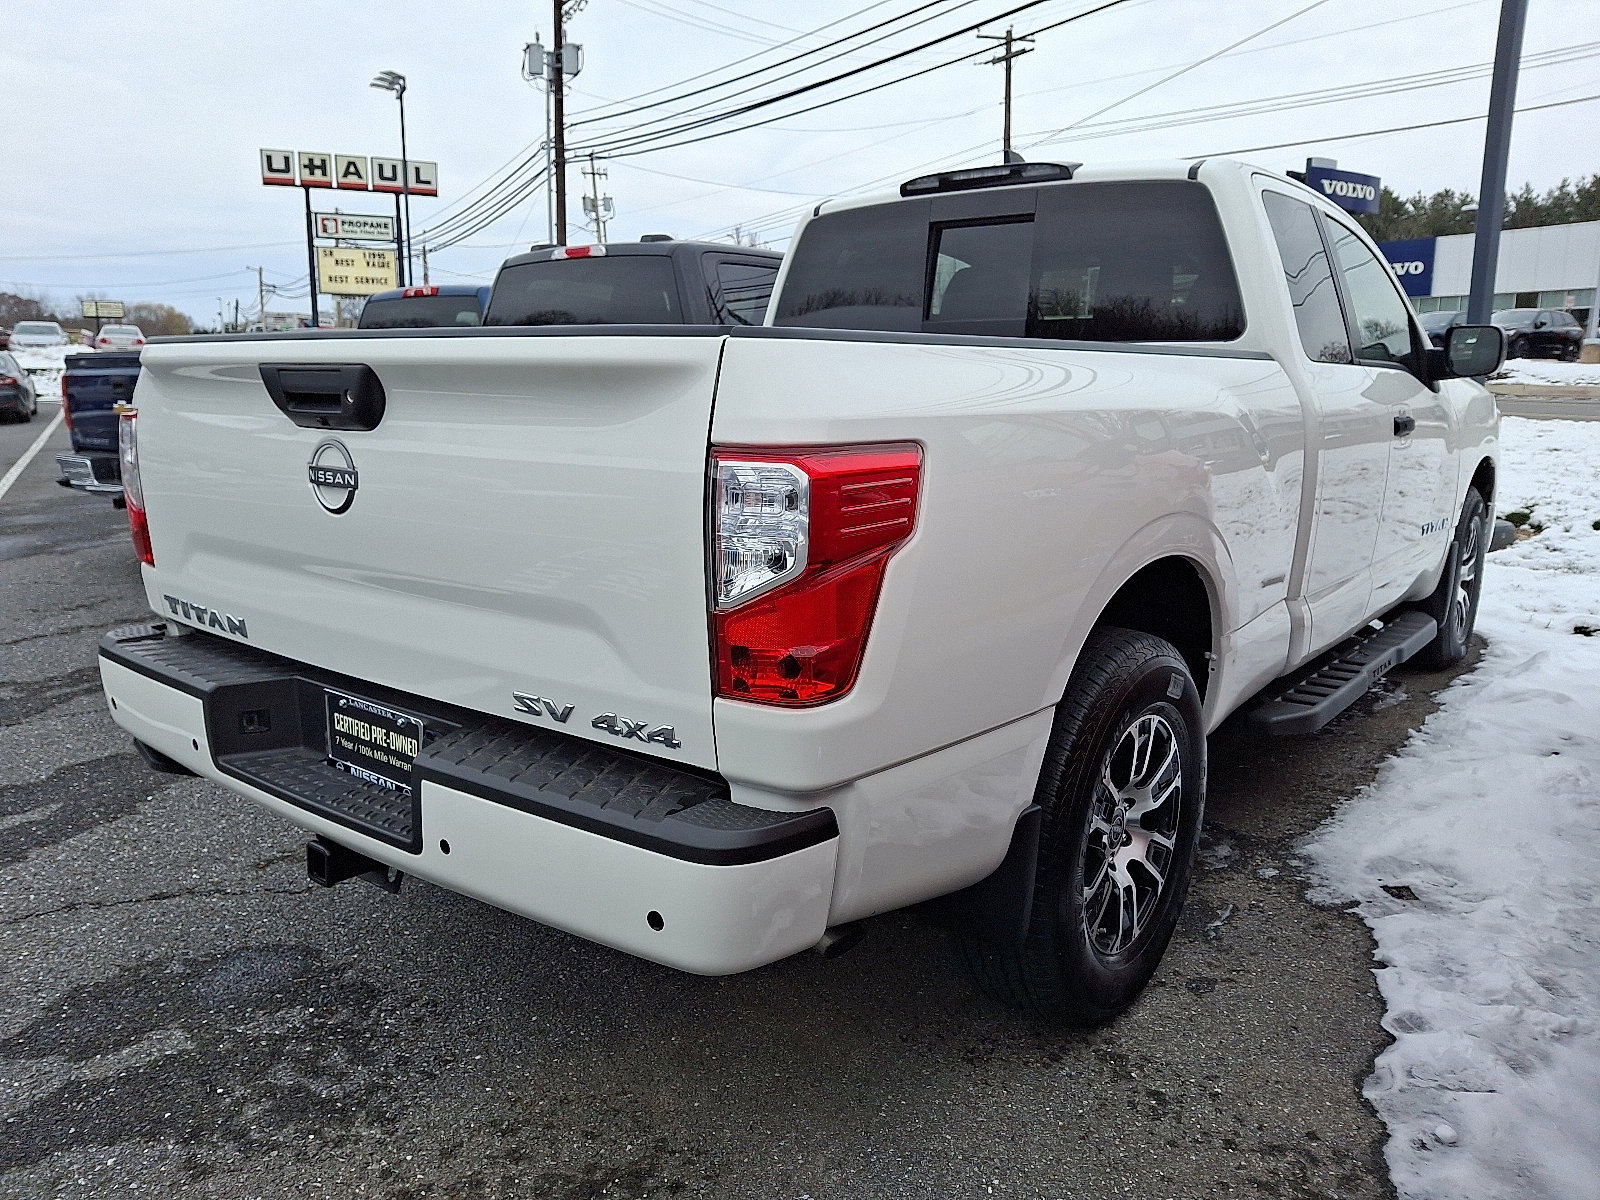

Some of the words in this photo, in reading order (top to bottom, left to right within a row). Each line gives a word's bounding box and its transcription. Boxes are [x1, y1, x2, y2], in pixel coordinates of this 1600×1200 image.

[1320, 179, 1376, 201] VOLVO
[341, 220, 389, 229] PROPANE
[335, 258, 355, 267] BEST
[366, 261, 391, 269] VALUE
[328, 275, 349, 284] BEST
[354, 276, 388, 286] SERVICE
[309, 468, 355, 486] NISSAN
[163, 593, 248, 640] TITAN
[512, 690, 575, 723] SV
[333, 712, 370, 741] CERTIFIED
[371, 725, 418, 758] PRE-OWNED
[335, 735, 340, 745] 7
[340, 737, 354, 749] Year
[358, 745, 374, 758] 100k
[373, 750, 389, 763] Mile
[388, 754, 412, 772] Warran
